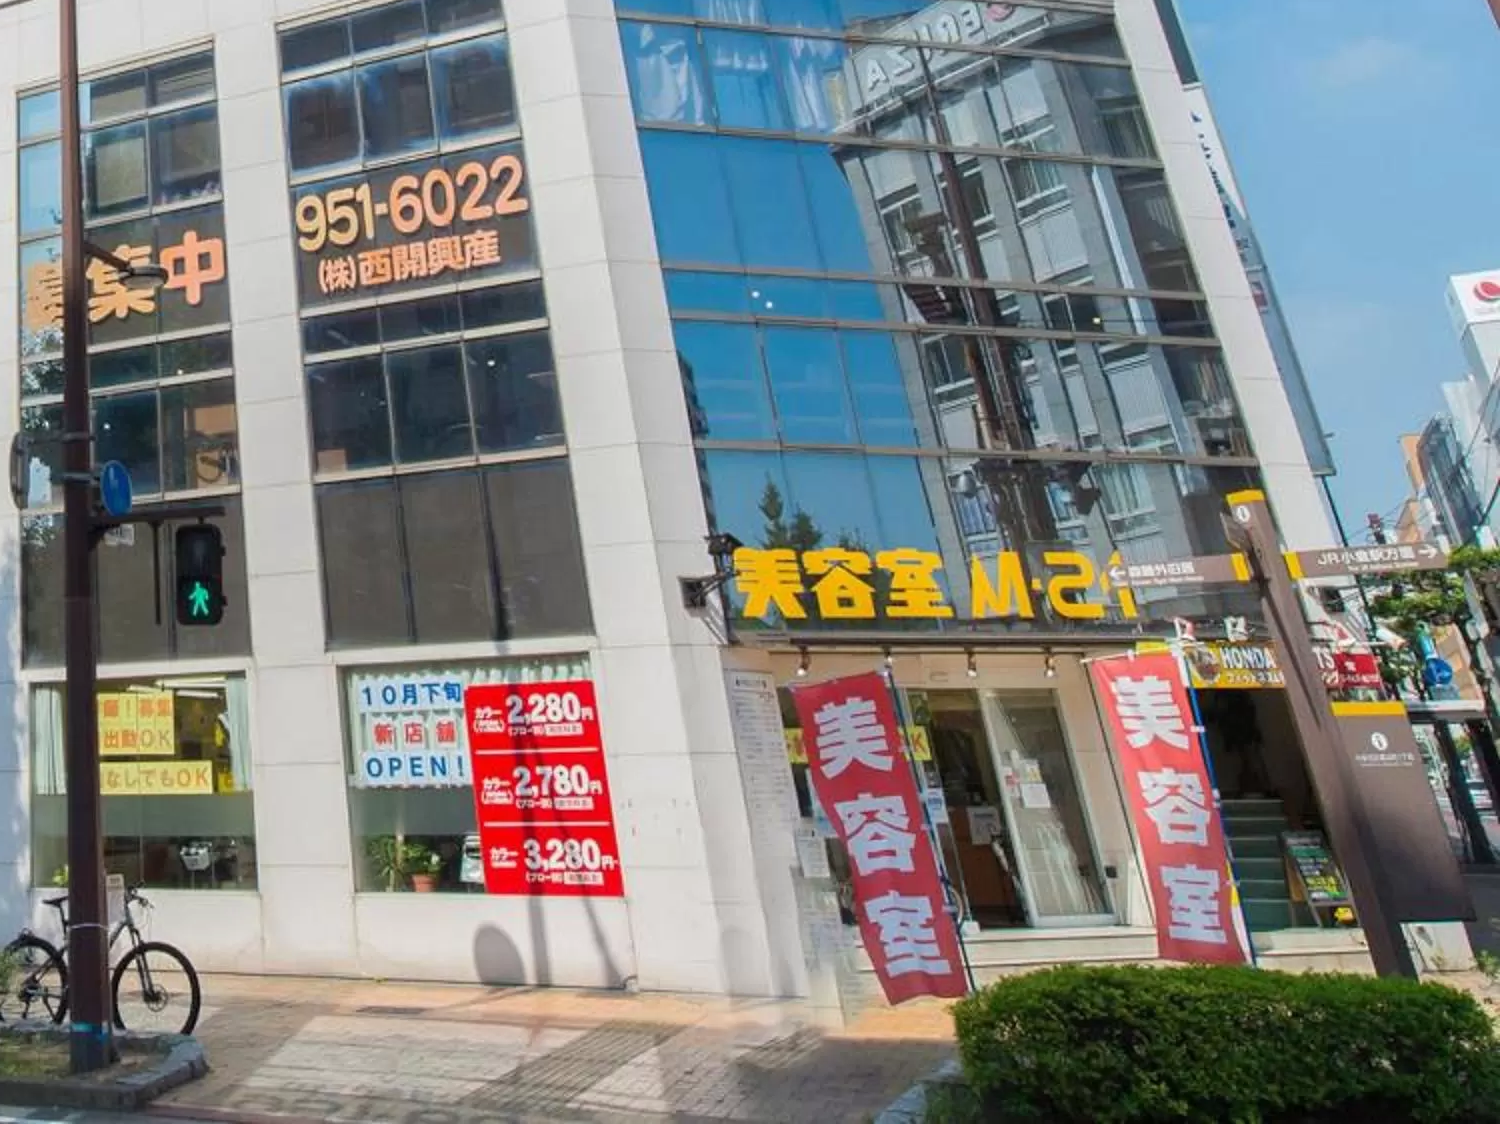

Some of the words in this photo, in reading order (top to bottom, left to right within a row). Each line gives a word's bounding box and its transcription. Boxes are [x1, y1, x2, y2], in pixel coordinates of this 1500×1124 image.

[296, 155, 529, 252] 951-6022
[732, 547, 954, 620] 美容室
[361, 681, 462, 706] 10月下旬
[1220, 646, 1278, 670] HONDA
[366, 756, 465, 778] OPEN!
[812, 696, 953, 977] 美容室
[1109, 675, 1228, 944] 美容室
